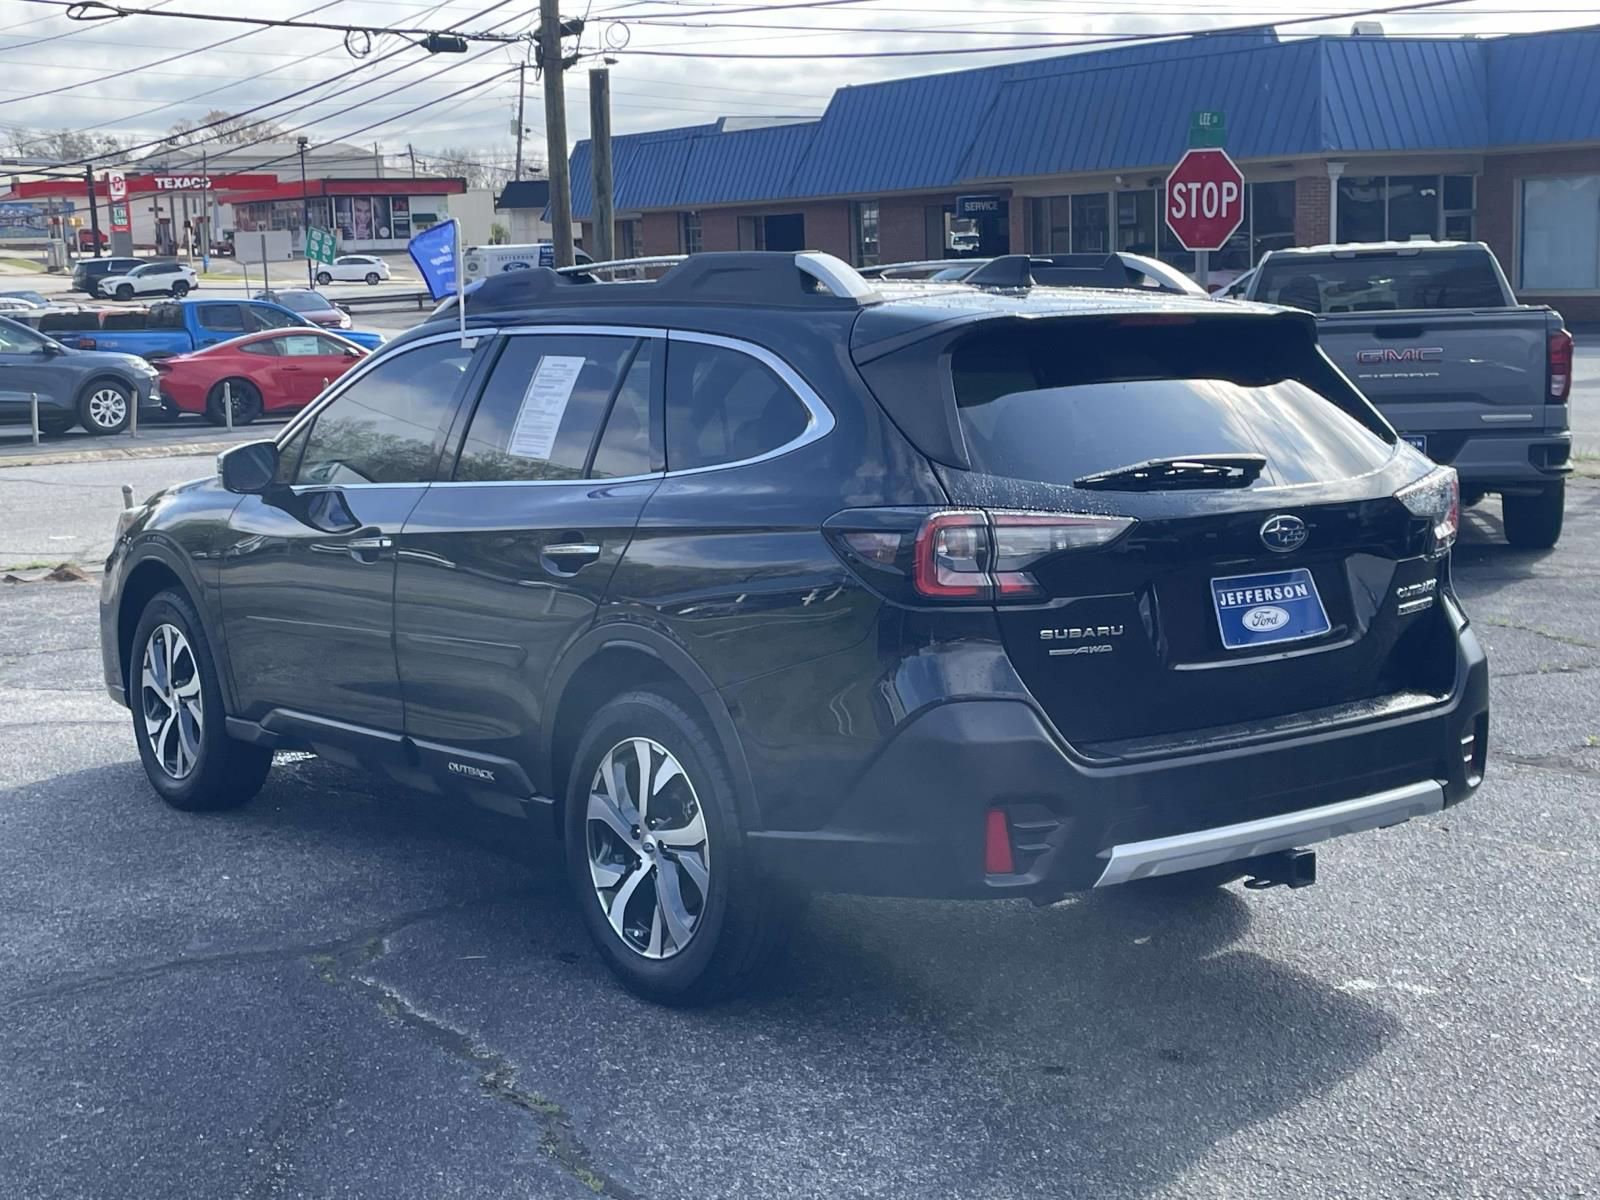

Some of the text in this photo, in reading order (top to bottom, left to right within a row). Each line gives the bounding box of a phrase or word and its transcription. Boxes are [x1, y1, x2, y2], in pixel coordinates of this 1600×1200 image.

[1199, 112, 1211, 126] LEE
[154, 177, 212, 189] TEXACO
[964, 201, 998, 211] SERVICE
[1171, 181, 1238, 219] STOP
[1356, 347, 1443, 363] GMC
[1220, 583, 1308, 606] JEFFERSON
[1252, 611, 1278, 627] Ford
[1040, 625, 1124, 640] SUBARU
[1073, 644, 1113, 655] AWD
[448, 762, 496, 781] OUTBACK
